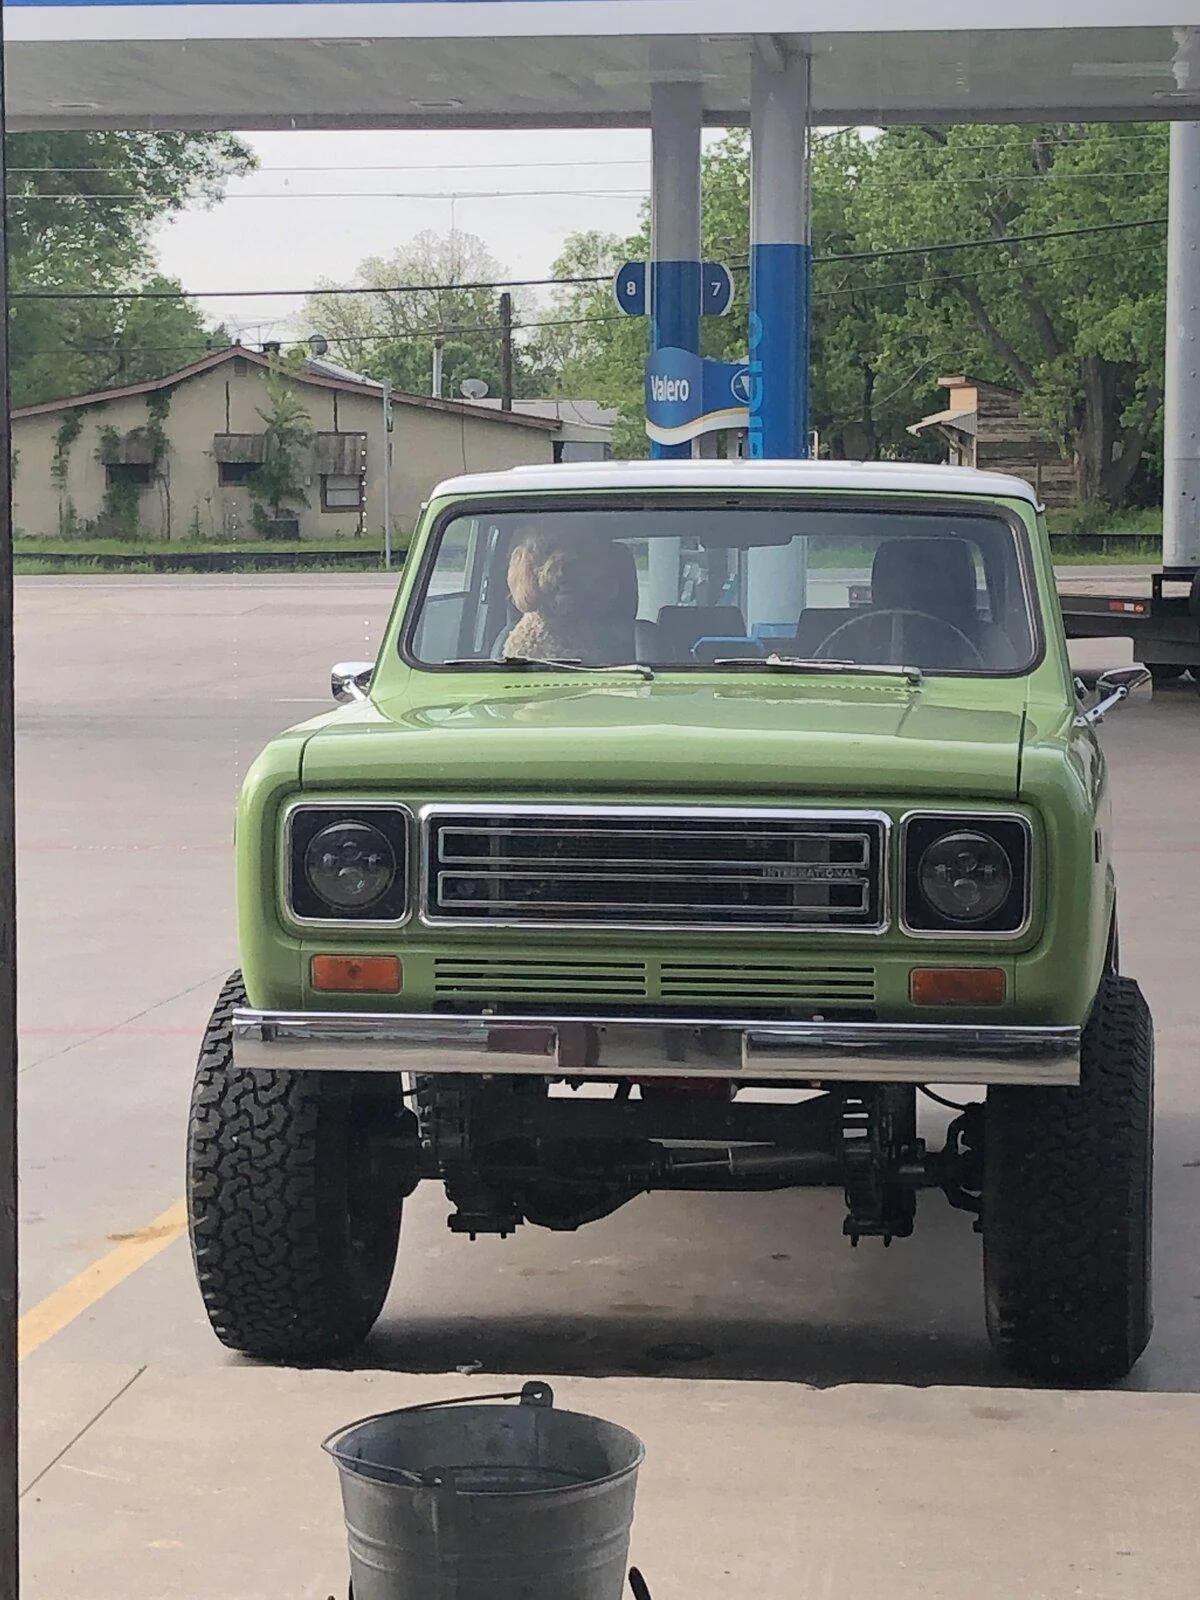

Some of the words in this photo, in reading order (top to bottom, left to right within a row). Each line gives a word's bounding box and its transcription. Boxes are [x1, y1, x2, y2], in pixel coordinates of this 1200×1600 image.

[626, 281, 636, 296] 8
[711, 282, 721, 296] 7
[650, 375, 690, 402] Valero
[762, 867, 858, 878] INTERNATIONAL
